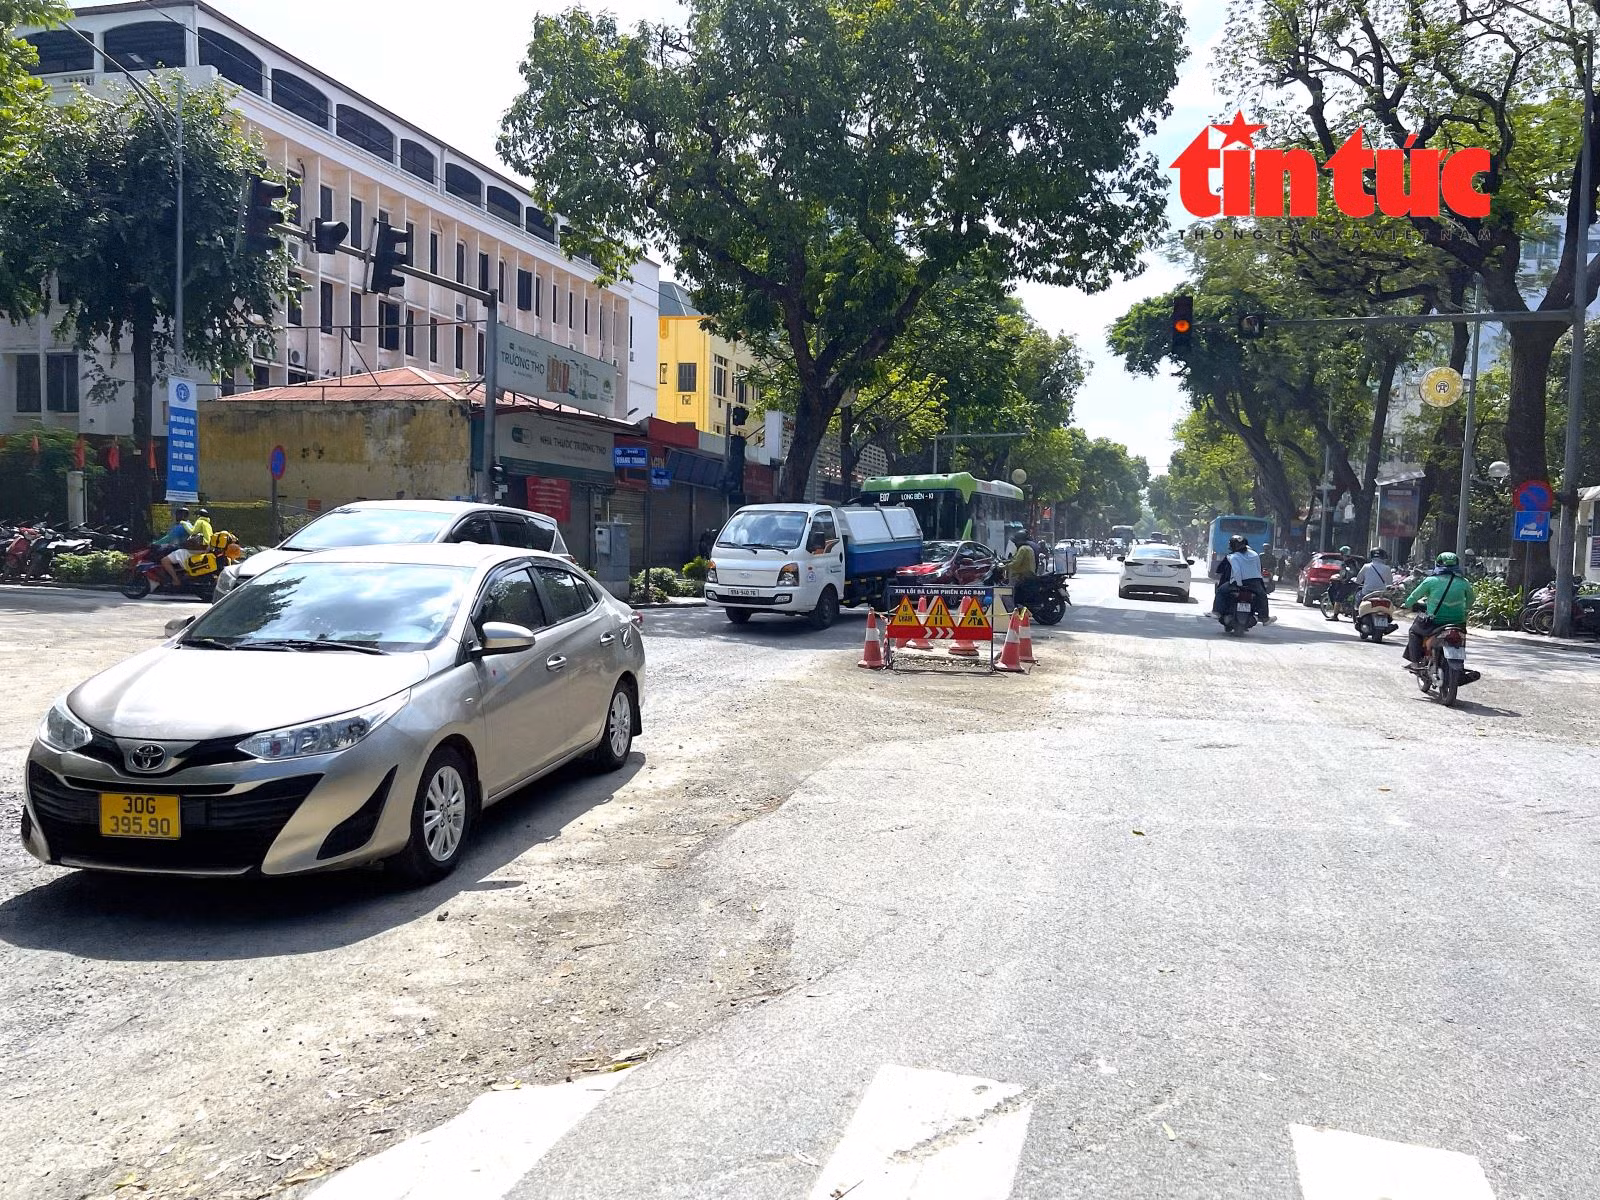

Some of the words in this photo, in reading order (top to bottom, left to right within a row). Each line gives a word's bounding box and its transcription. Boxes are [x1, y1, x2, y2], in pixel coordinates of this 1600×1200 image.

[880, 492, 890, 501] E07
[123, 796, 156, 814] 30G
[110, 815, 171, 836] 395.90
